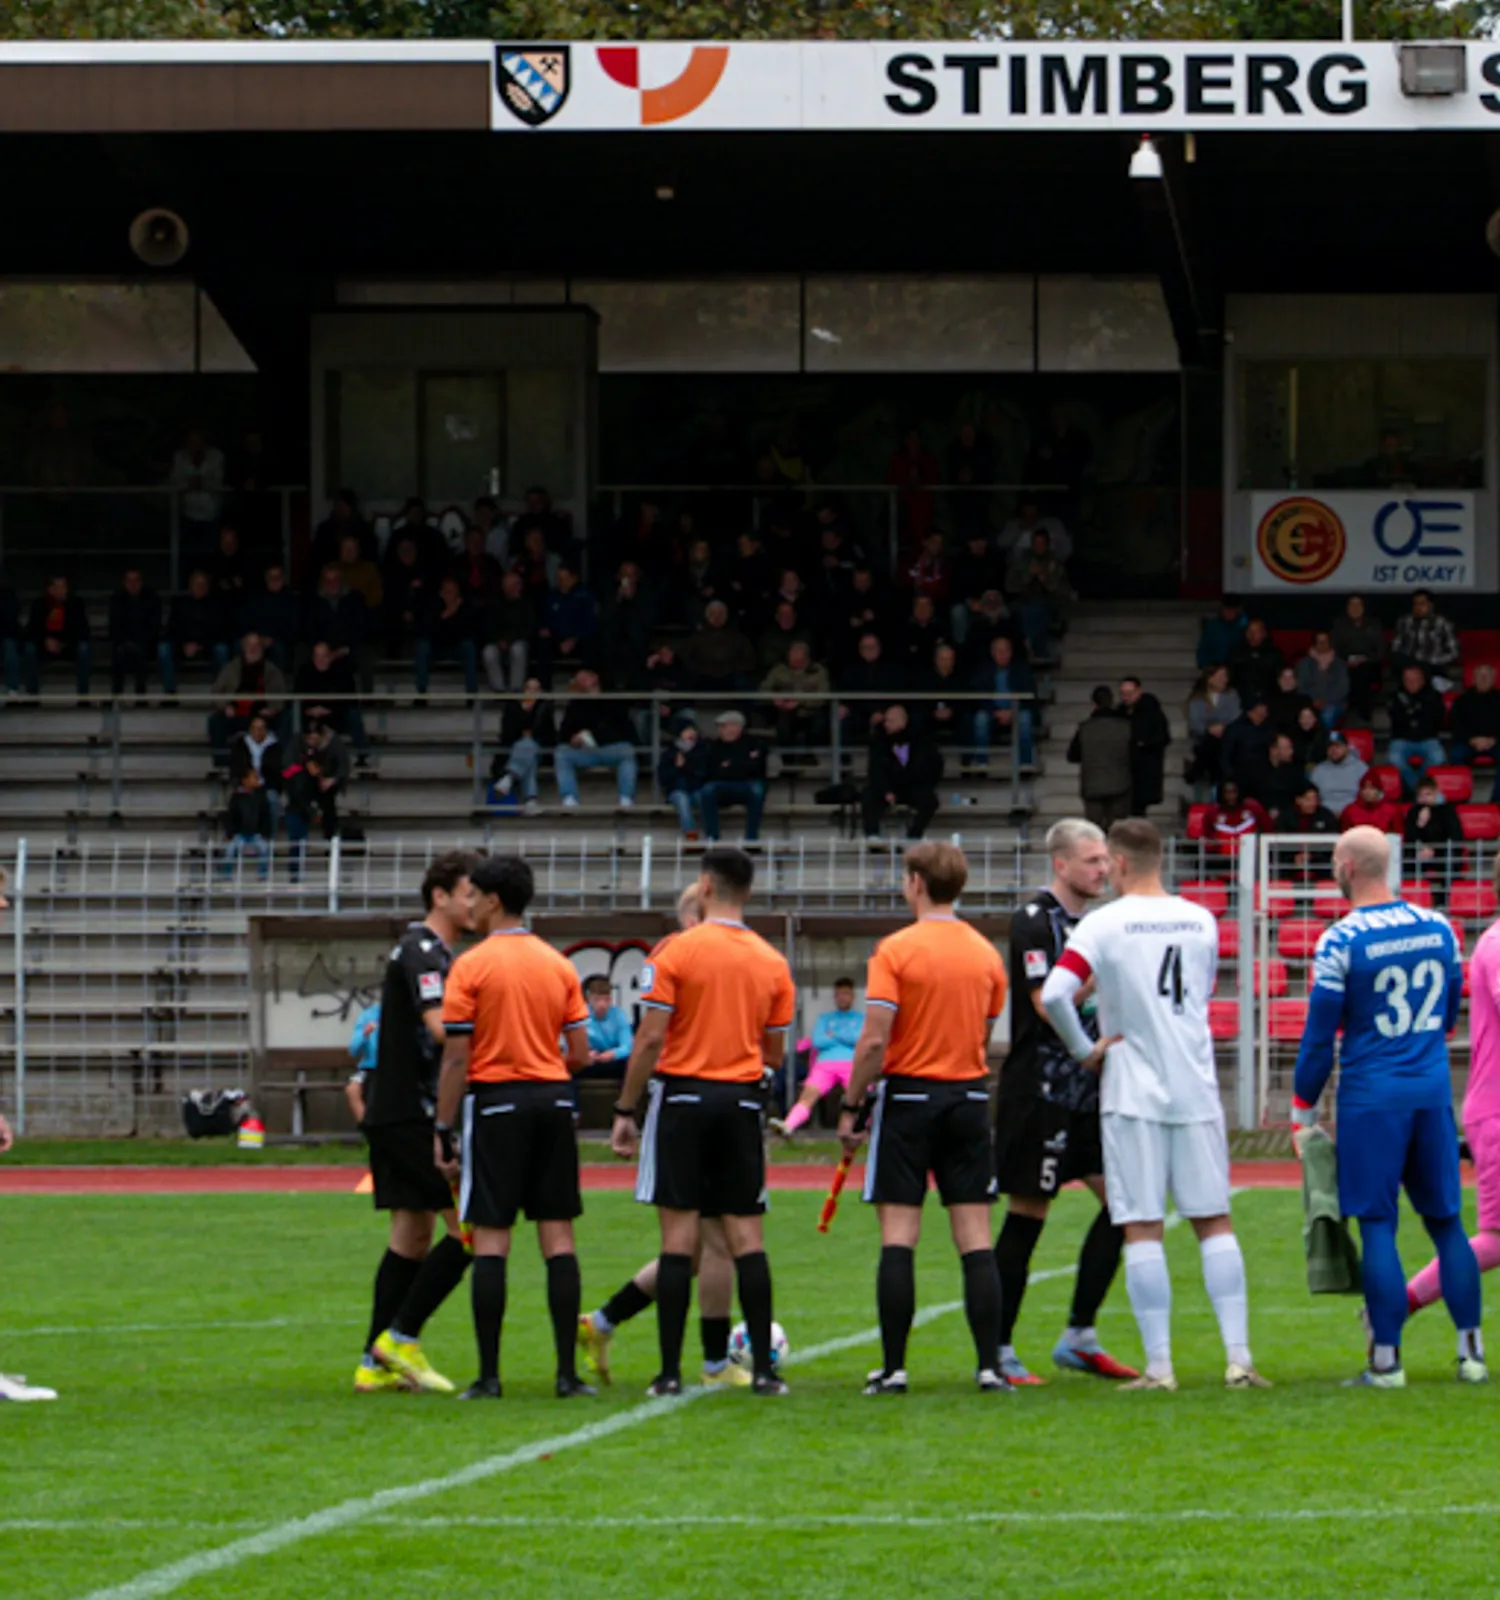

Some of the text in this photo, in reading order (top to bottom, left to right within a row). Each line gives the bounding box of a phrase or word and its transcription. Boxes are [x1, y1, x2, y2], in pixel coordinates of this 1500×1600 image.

[884, 53, 1368, 116] STIMBERG
[1372, 565, 1398, 582] IST
[1157, 944, 1188, 1015] 4
[1374, 958, 1444, 1038] 32
[1039, 1157, 1058, 1191] 5
